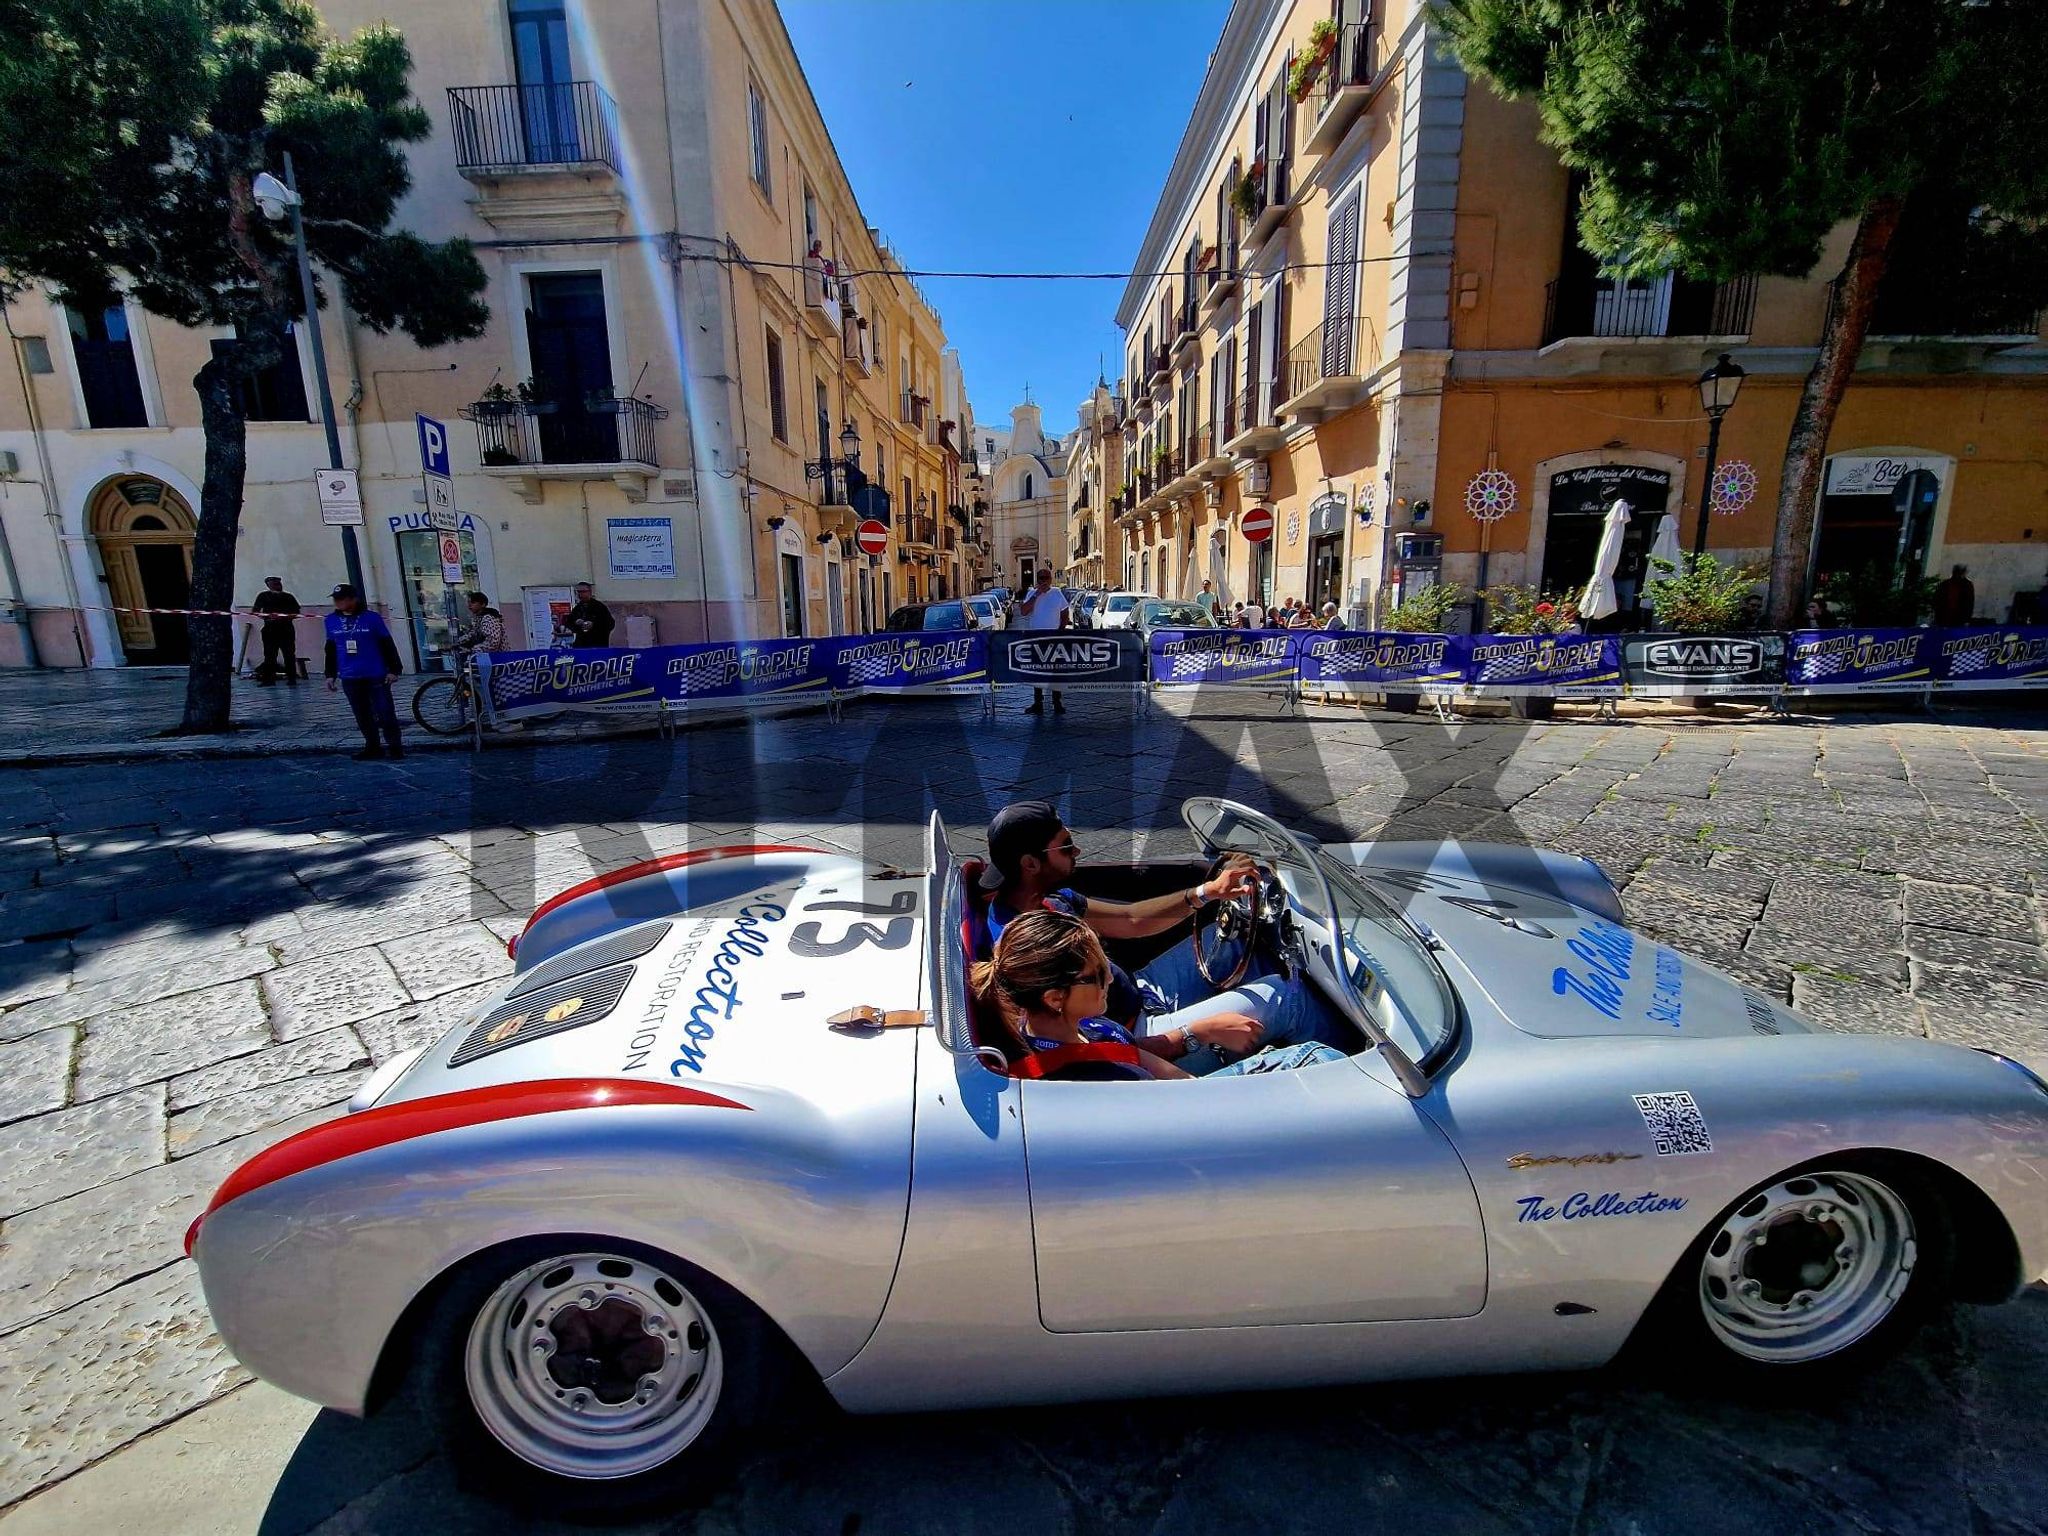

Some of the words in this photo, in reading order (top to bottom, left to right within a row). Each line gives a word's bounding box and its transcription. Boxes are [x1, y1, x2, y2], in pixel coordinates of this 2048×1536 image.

[423, 421, 443, 467] P
[1554, 474, 1569, 486] La
[1572, 469, 1618, 484] Caffetteria
[1618, 468, 1636, 478] del
[1636, 470, 1668, 485] Castello
[1872, 459, 1907, 482] Bar
[838, 638, 900, 665] ROYAL
[887, 638, 969, 675] PURPLE
[1014, 643, 1111, 663] EVANS
[1163, 634, 1222, 657] ROYAL
[1207, 636, 1289, 669] PURPLE
[1311, 635, 1376, 657] ROYAL
[1359, 641, 1444, 671] PURPLE
[1472, 639, 1536, 661] ROYAL
[1522, 640, 1603, 673] PURPLE
[1650, 644, 1753, 665] EVANS
[1794, 634, 1855, 660] ROYAL
[1839, 635, 1919, 672] PURPLE
[1942, 631, 2000, 656] ROYAL
[1984, 638, 2048, 668] PURP
[491, 655, 550, 678] OYAL
[534, 654, 634, 694] PURPLE
[667, 647, 737, 675] ROYAL
[724, 644, 810, 684] PURPLE
[795, 668, 808, 676] OIL
[568, 681, 614, 696] SYNTHETIC
[617, 678, 632, 686] OIL
[788, 891, 918, 957] 73
[670, 904, 787, 1077] Collection
[622, 940, 703, 1071] RESTORATION
[1516, 1196, 1561, 1223] The
[1562, 1191, 1689, 1220] Collection
